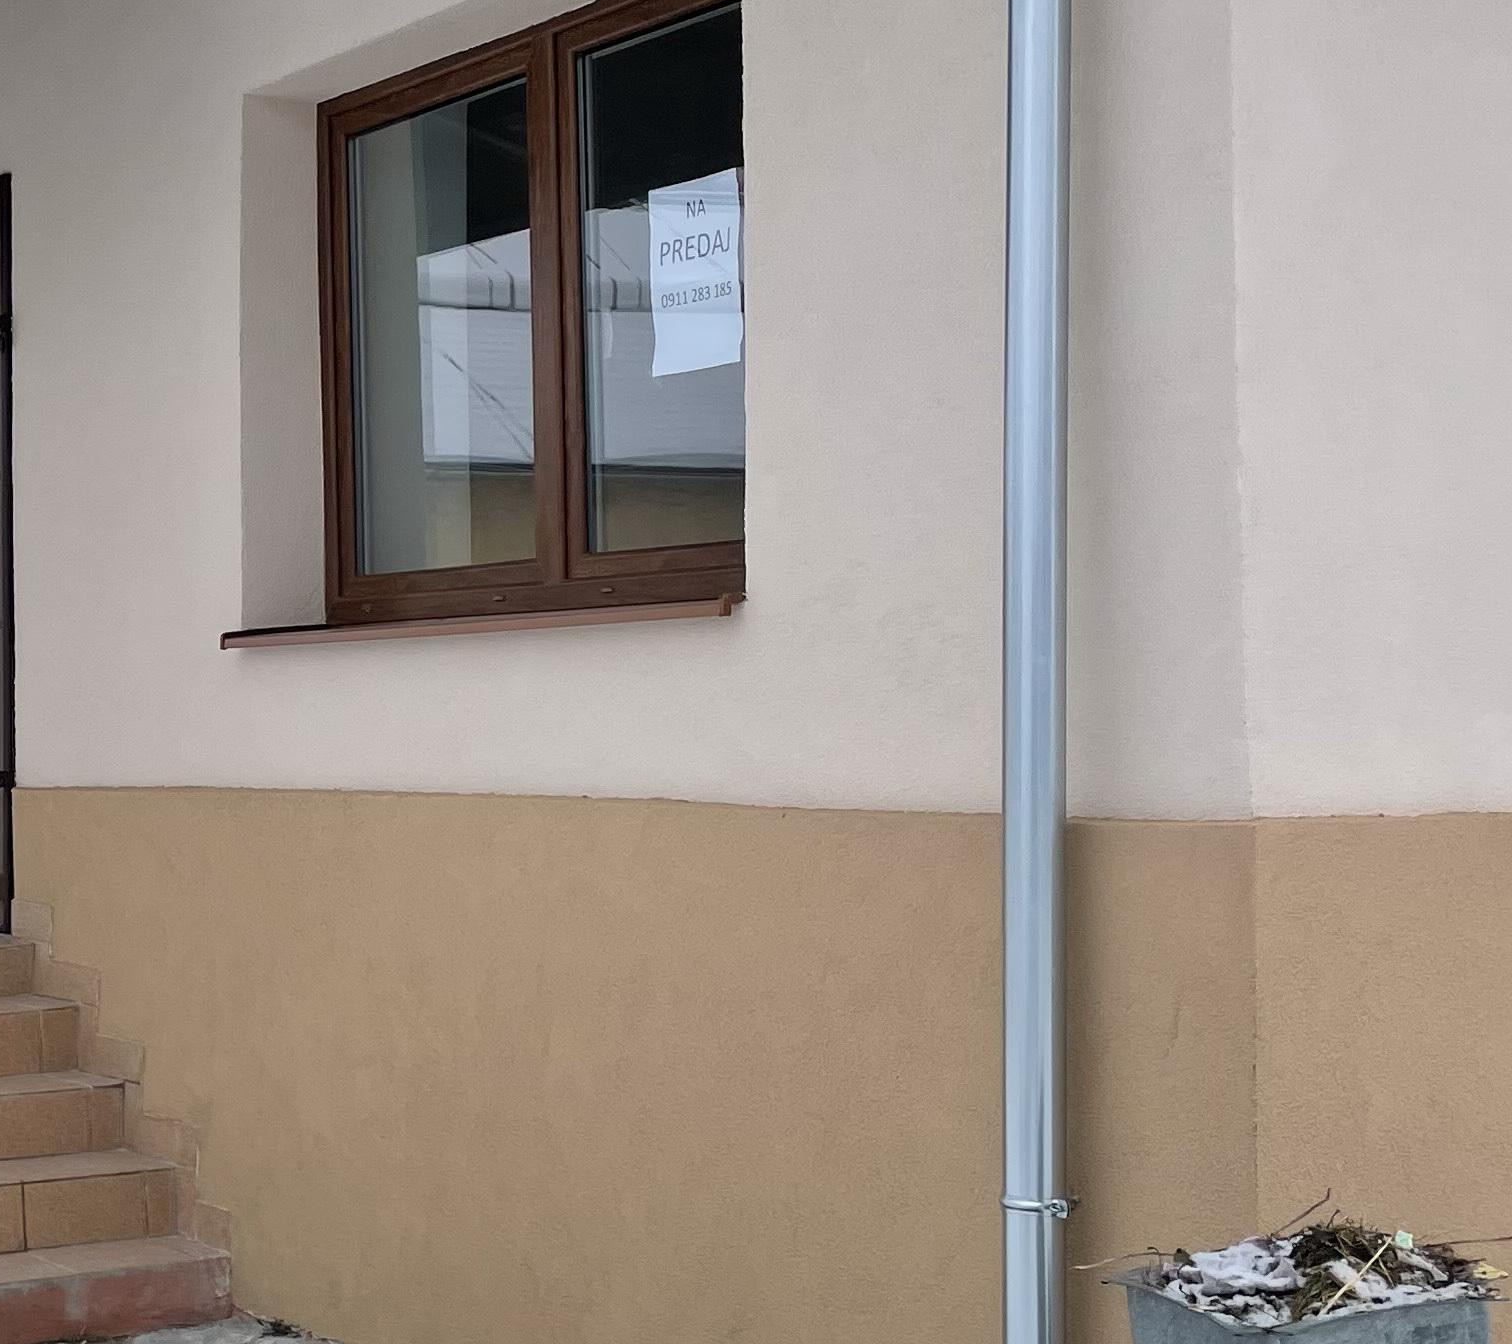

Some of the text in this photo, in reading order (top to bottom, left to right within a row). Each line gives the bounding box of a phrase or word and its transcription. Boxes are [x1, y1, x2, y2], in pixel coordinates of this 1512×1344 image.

[686, 199, 706, 219] NA
[660, 227, 731, 266] PREDAJ
[661, 281, 732, 308] 0911 283 185
